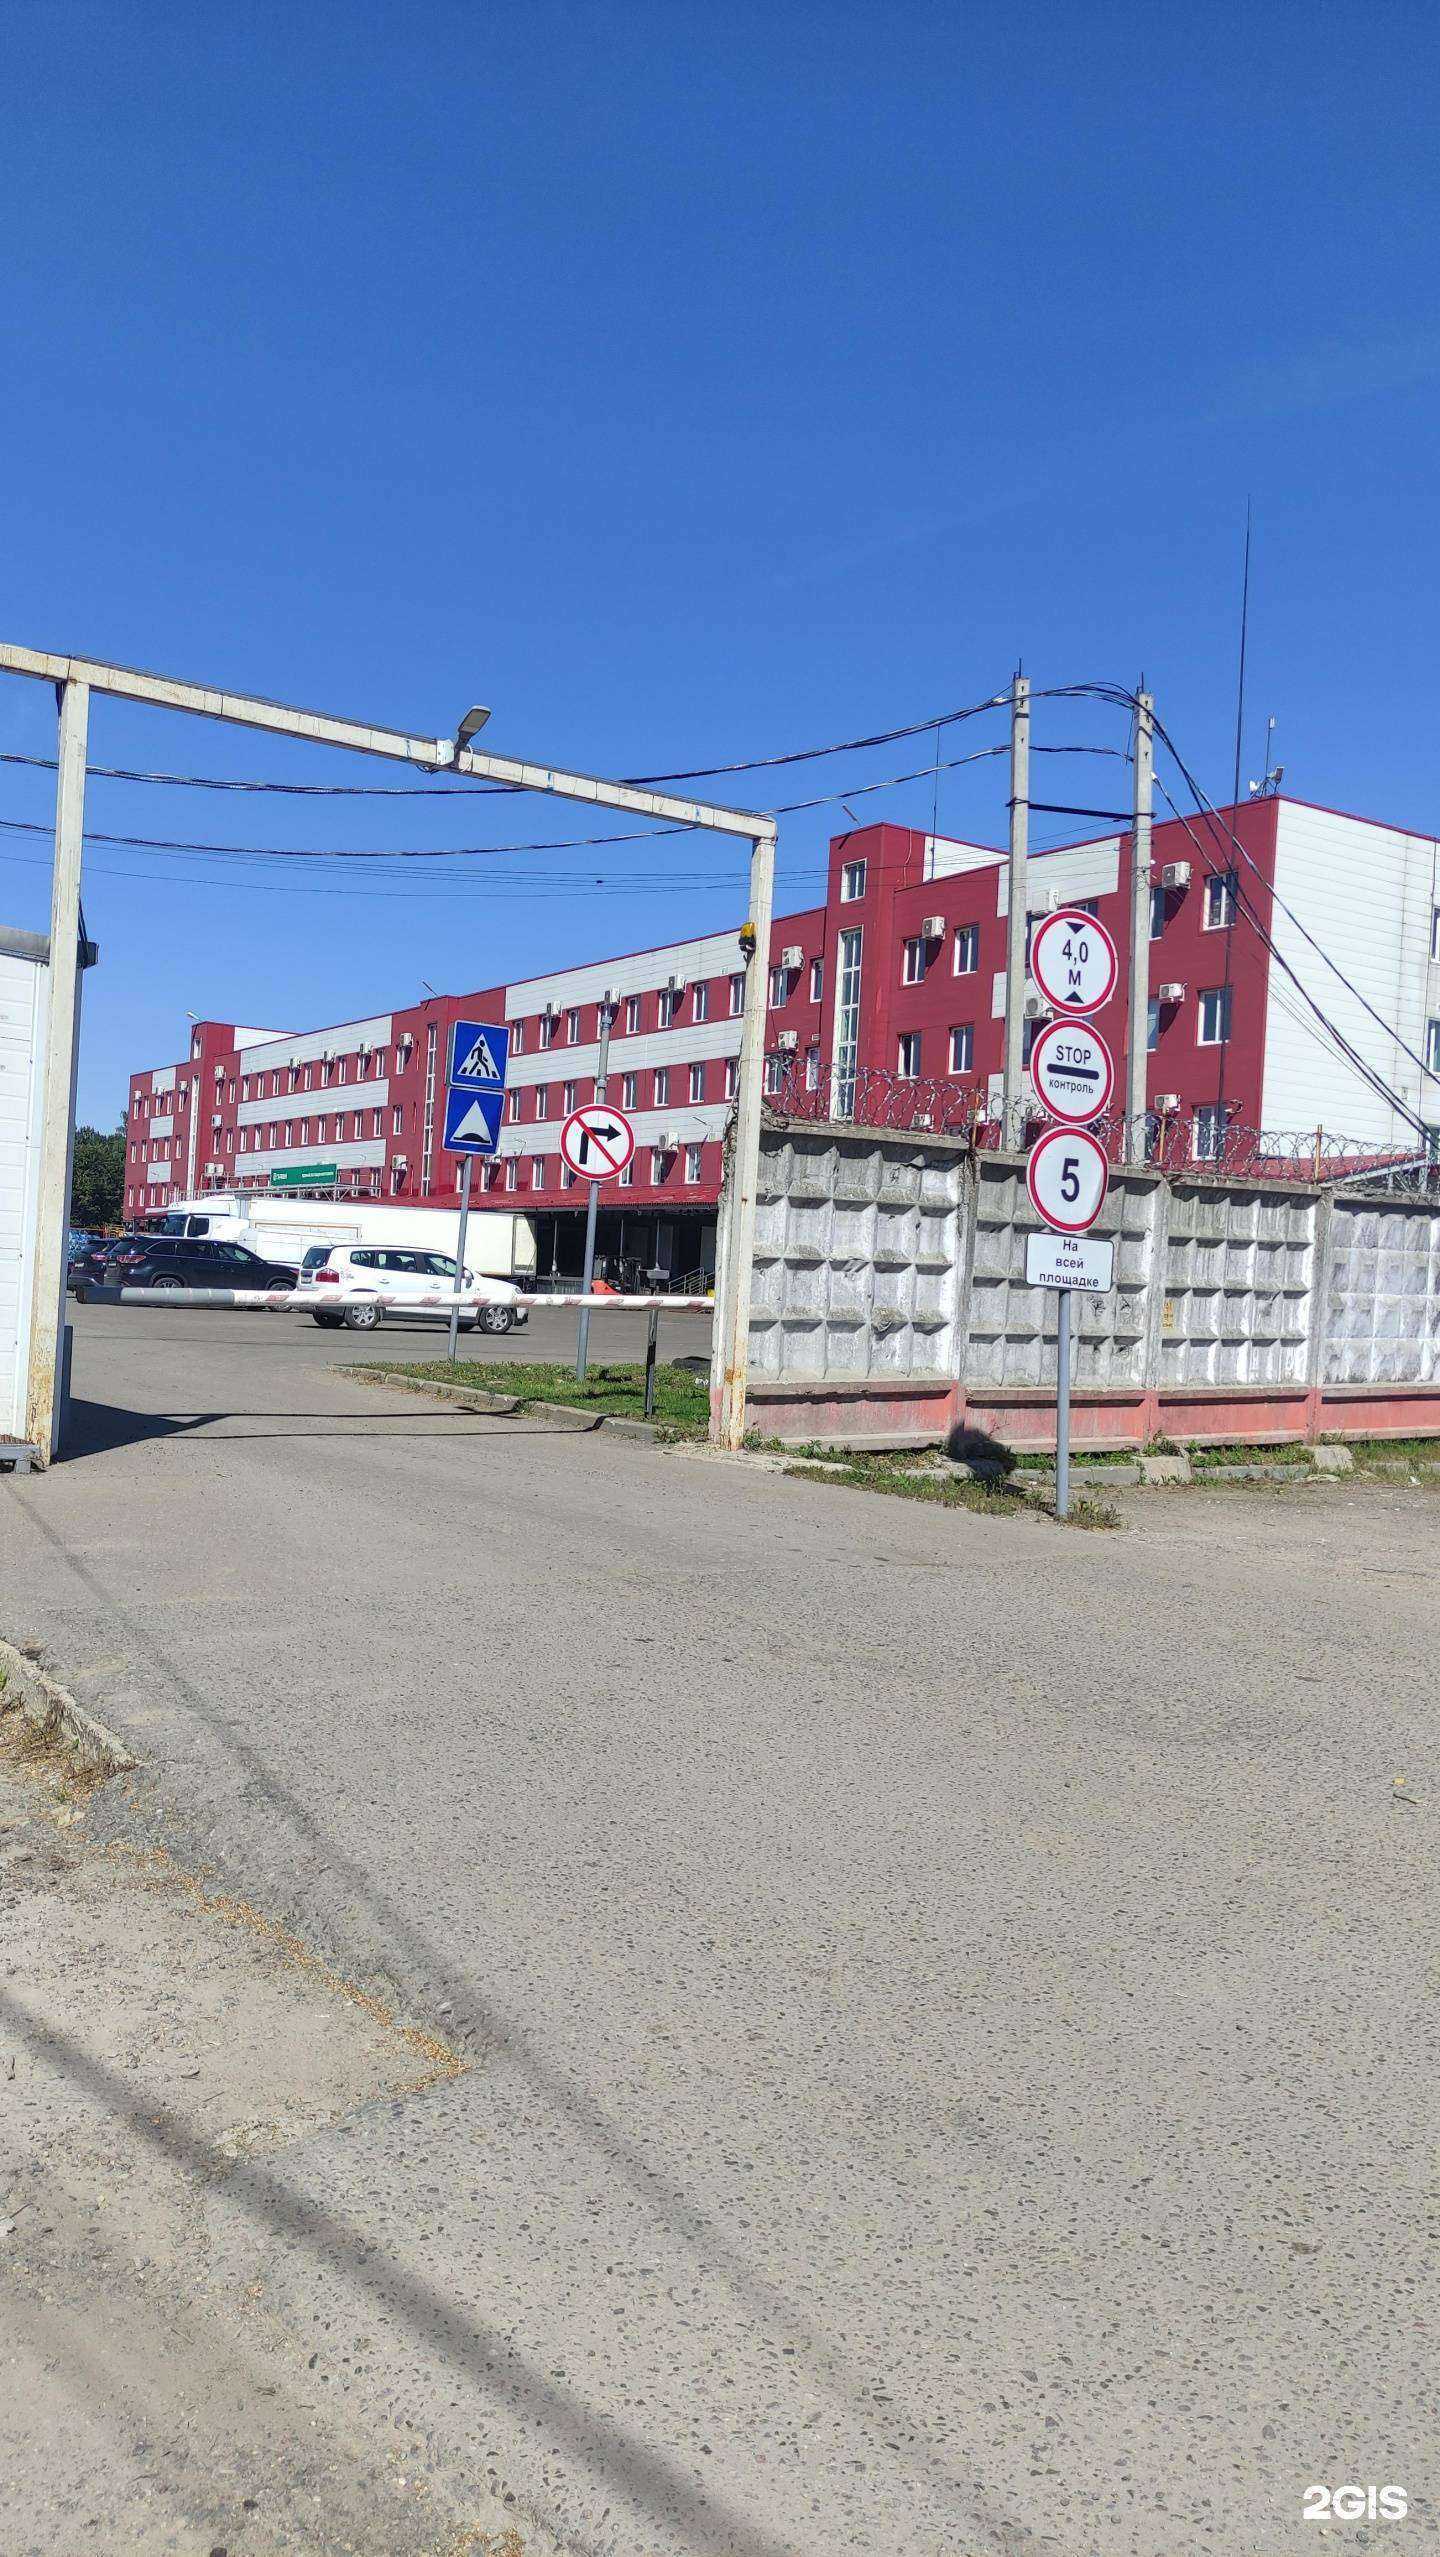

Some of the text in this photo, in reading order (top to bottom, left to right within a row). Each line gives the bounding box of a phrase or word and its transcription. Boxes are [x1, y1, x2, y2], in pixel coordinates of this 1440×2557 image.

[1062, 939, 1088, 965] 4,0
[1056, 1045, 1091, 1064] STOP
[1049, 1079, 1094, 1094] контроль
[1060, 1157, 1080, 1202] 5
[1063, 1239, 1078, 1252] На
[1055, 1257, 1084, 1269] всей
[1039, 1273, 1099, 1288] площадке
